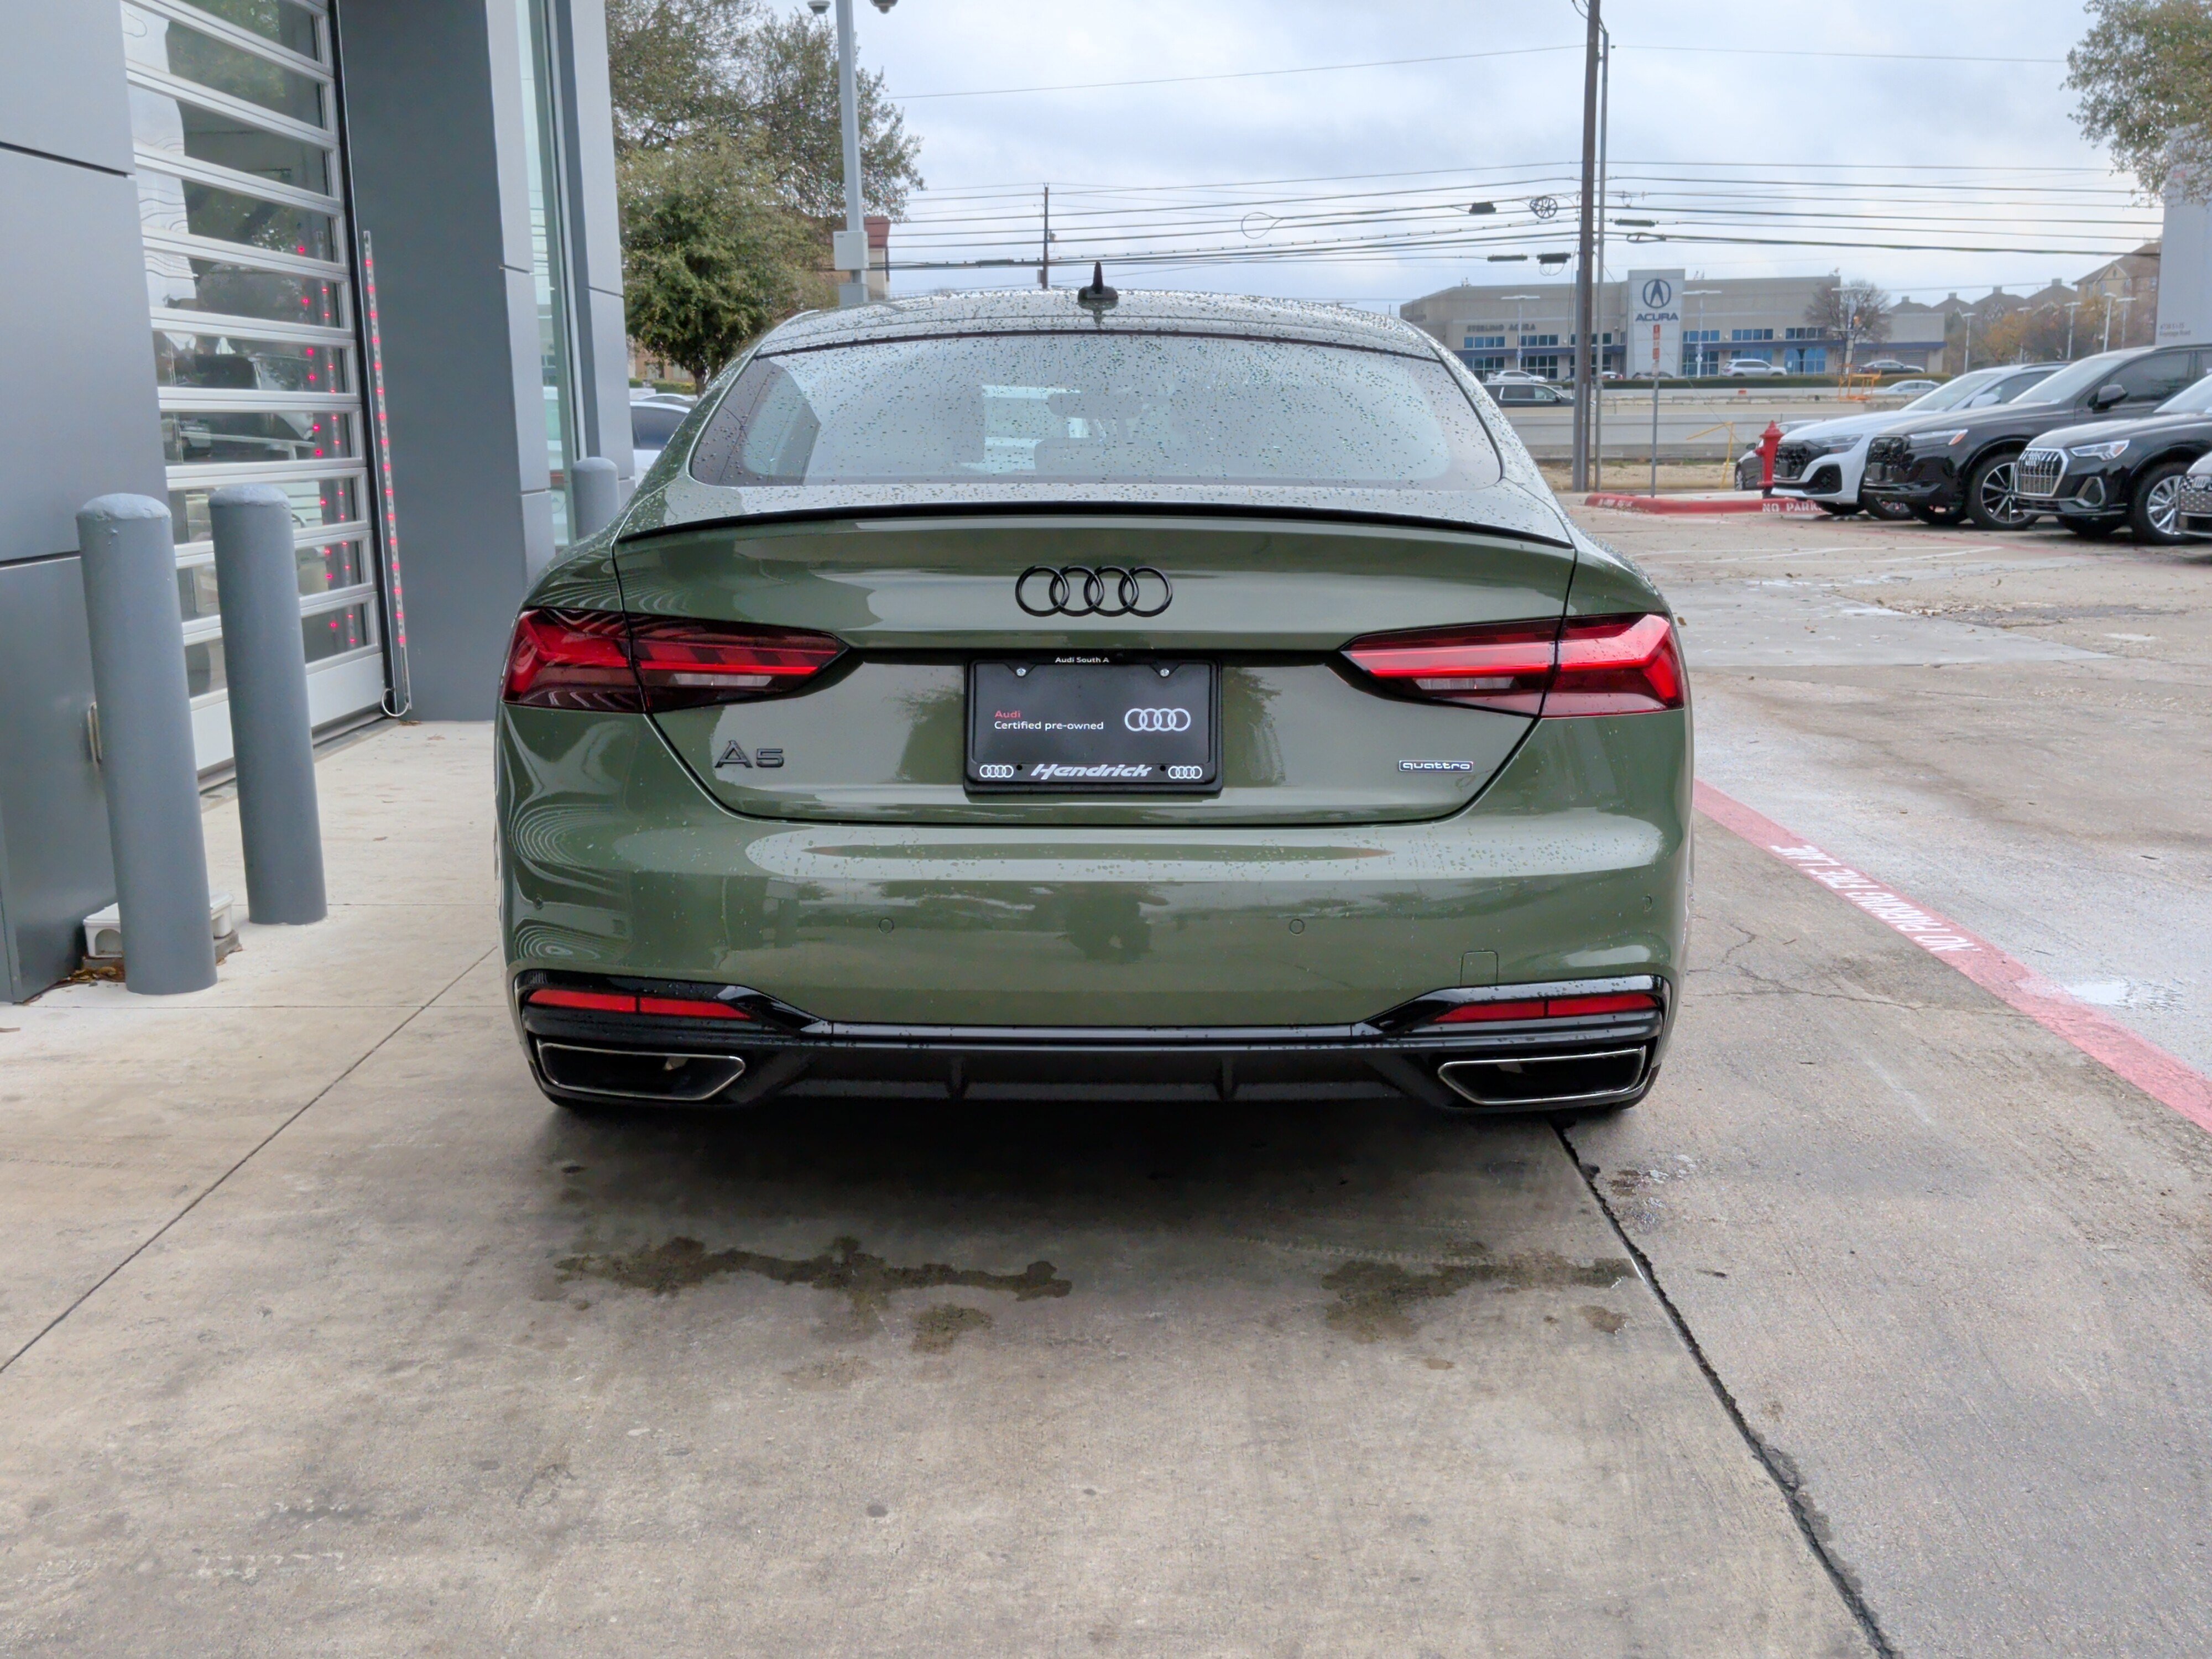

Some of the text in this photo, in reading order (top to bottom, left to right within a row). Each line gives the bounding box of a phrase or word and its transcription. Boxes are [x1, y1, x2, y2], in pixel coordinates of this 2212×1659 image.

[1635, 312, 1678, 321] ACURA
[1762, 502, 1822, 512] NO PARK
[995, 710, 1021, 718] Audi
[994, 721, 1104, 731] Certified pre-owned
[715, 740, 784, 768] A5
[1031, 764, 1152, 780] Hendrick
[1808, 869, 1879, 888] FIRE
[1845, 892, 1952, 931] PARKING
[1913, 935, 1981, 951] NO
